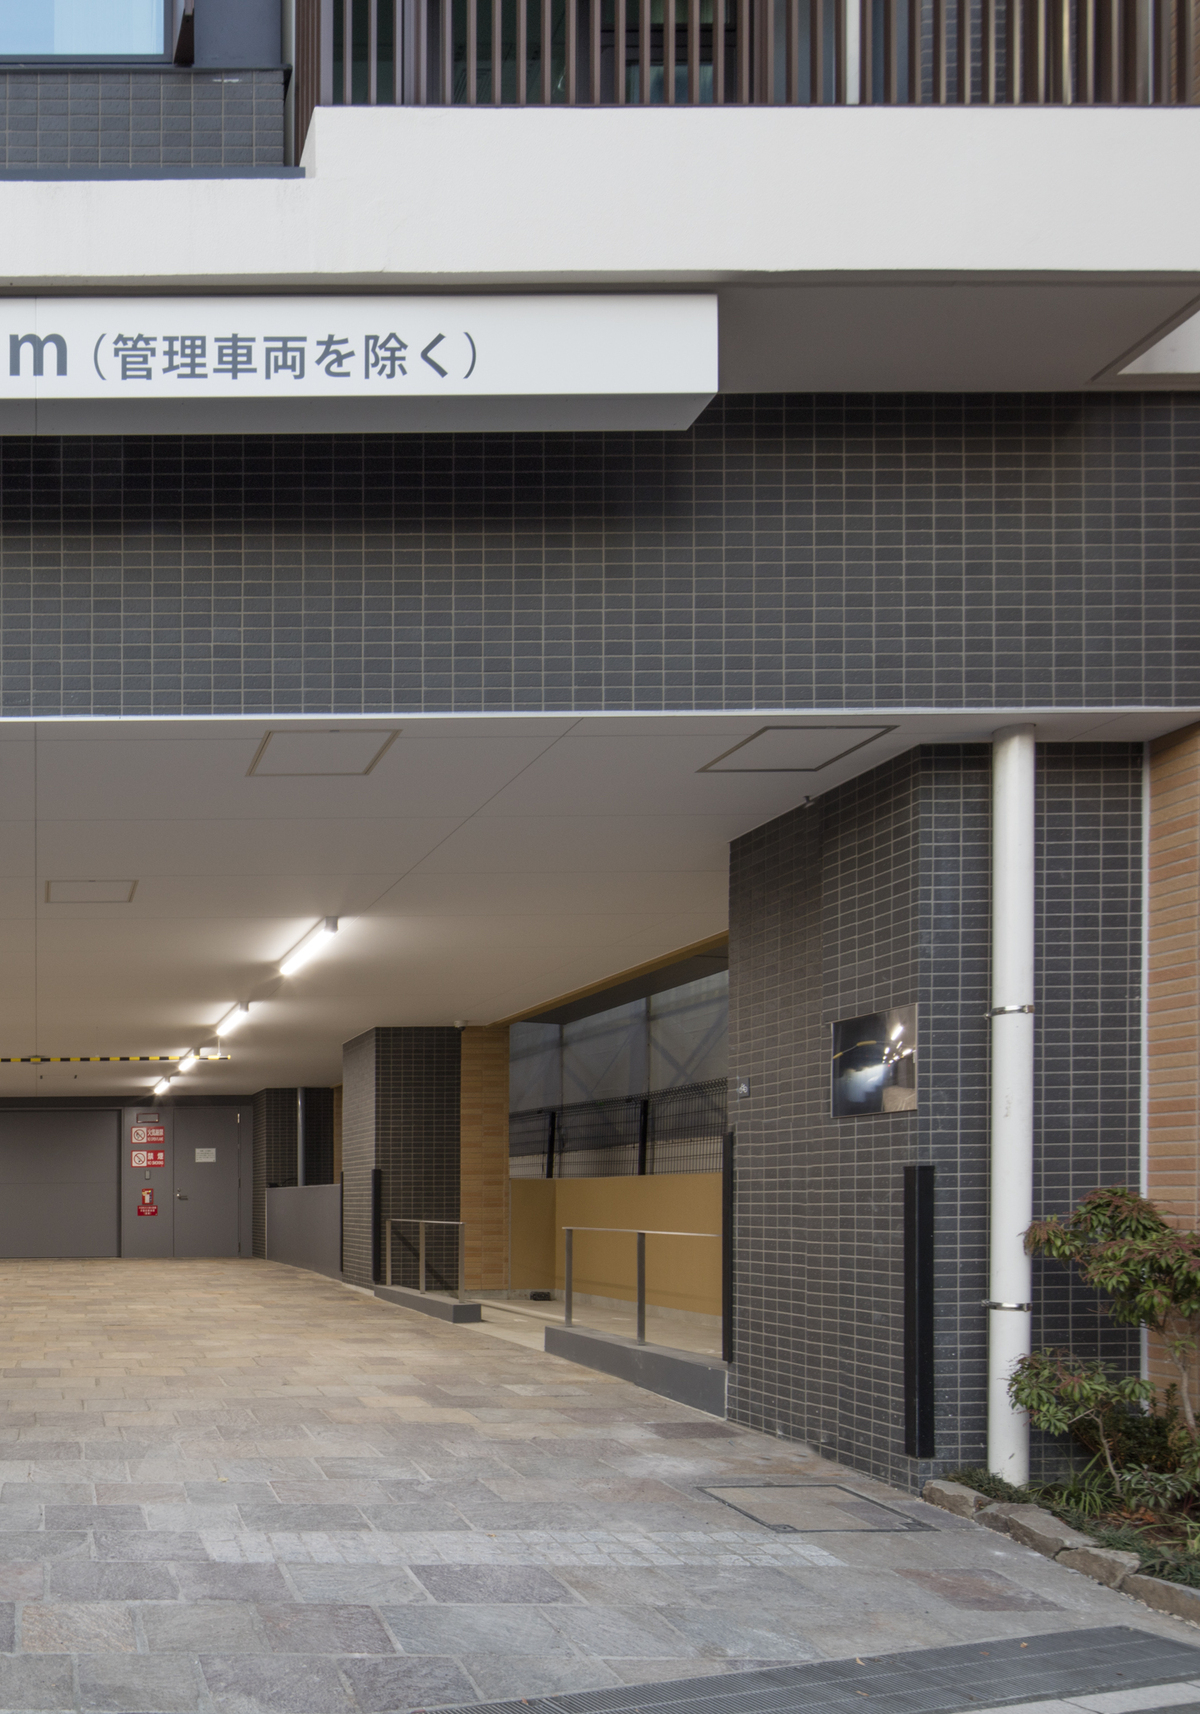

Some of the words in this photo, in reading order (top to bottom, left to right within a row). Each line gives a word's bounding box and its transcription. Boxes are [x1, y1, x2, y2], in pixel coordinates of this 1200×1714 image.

[93, 332, 477, 381] （管理車両を除く）
